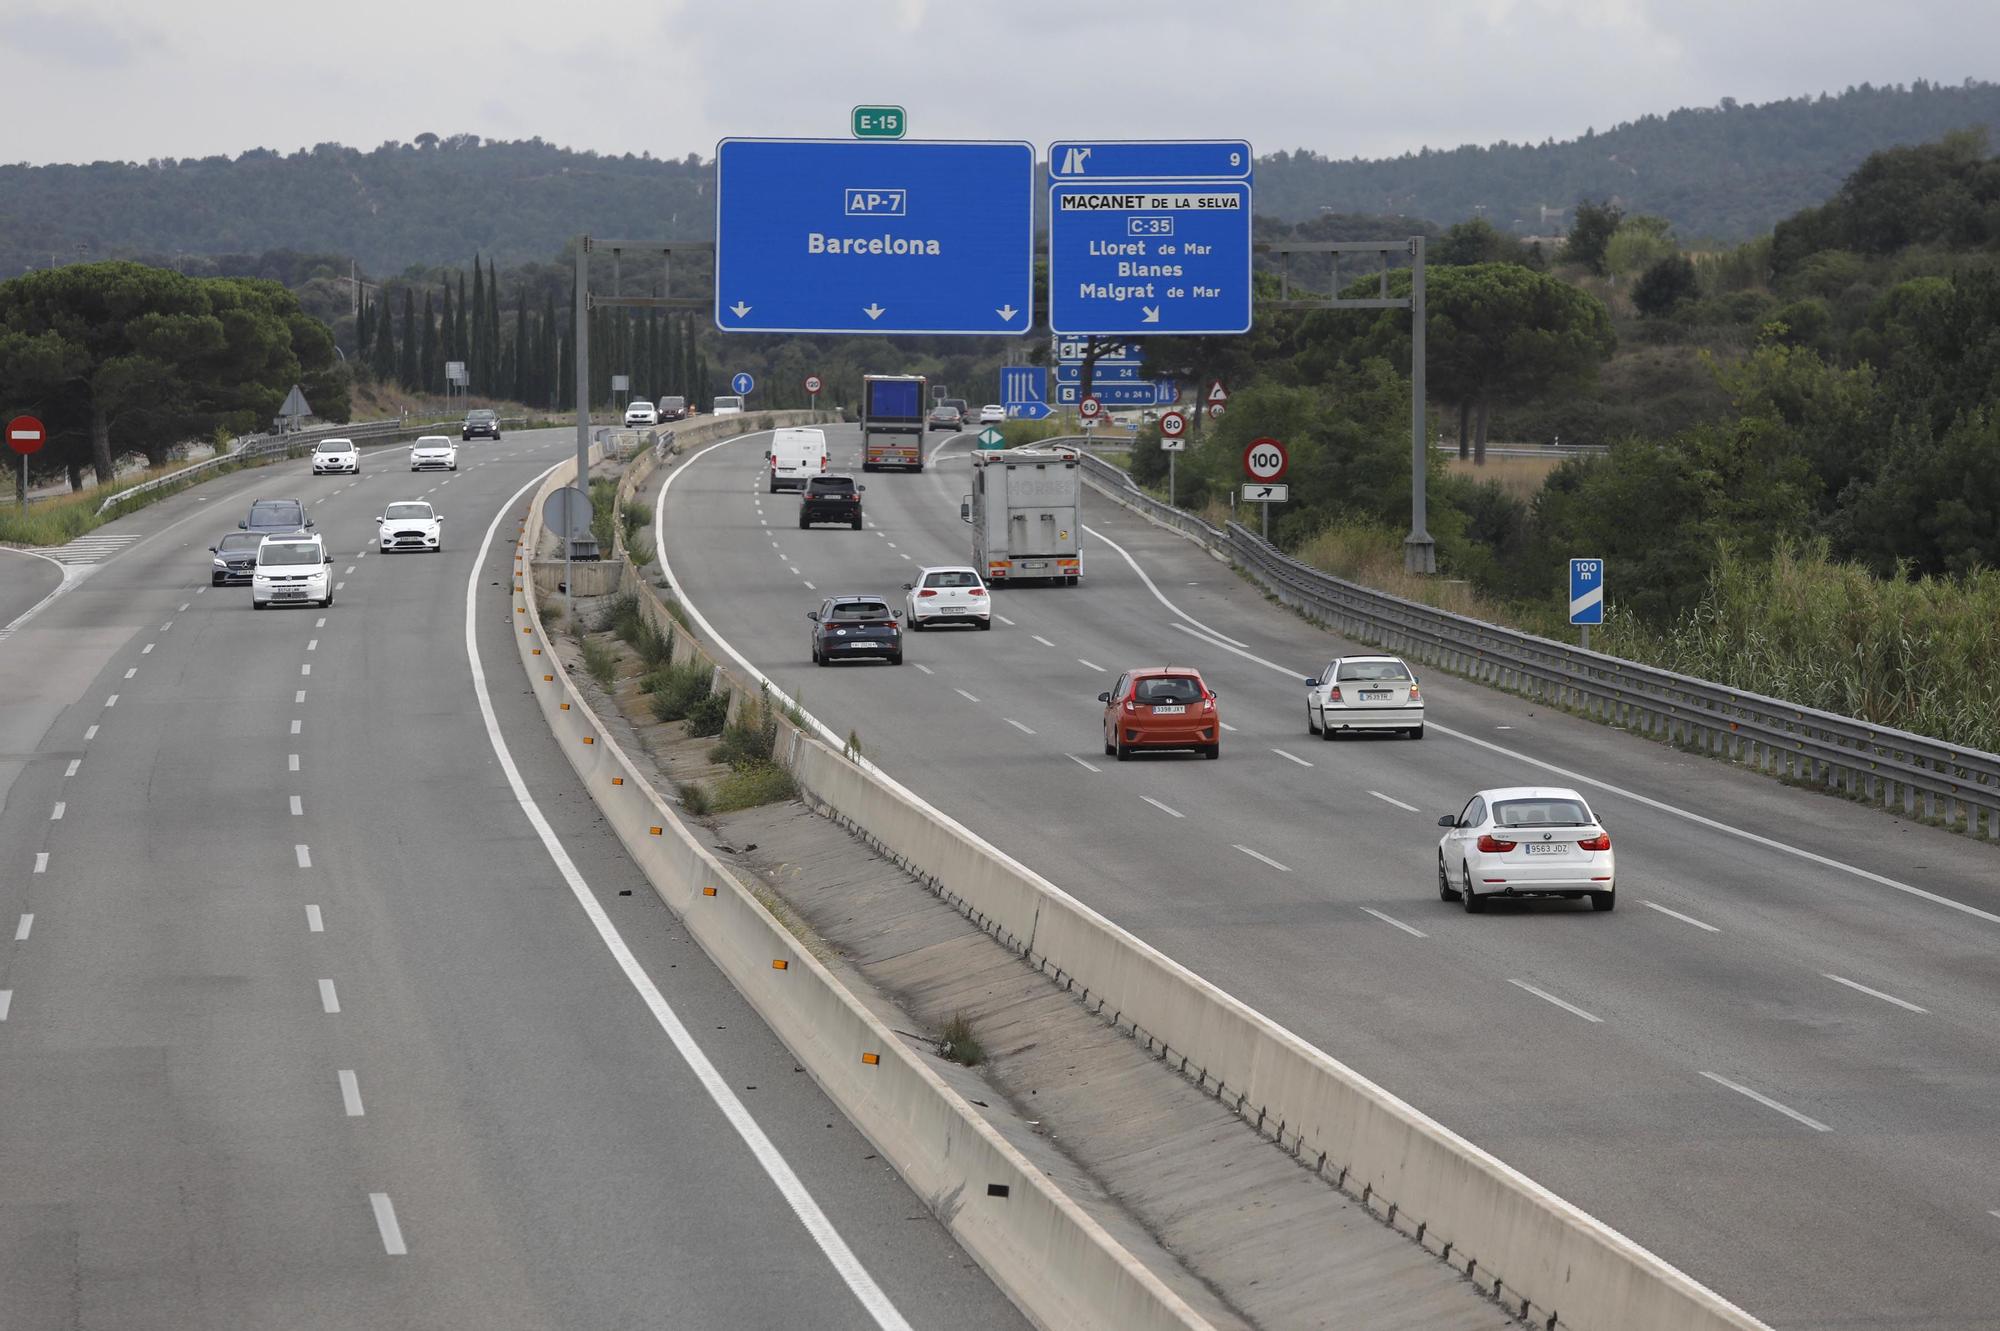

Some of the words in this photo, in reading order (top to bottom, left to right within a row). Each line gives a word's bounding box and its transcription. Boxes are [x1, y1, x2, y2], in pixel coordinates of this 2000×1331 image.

[860, 115, 898, 130] E-15
[1229, 152, 1241, 167] 9
[850, 193, 902, 211] AP-7
[1062, 195, 1146, 210] MAÇANET
[1151, 198, 1169, 209] DE
[1175, 198, 1191, 209] LA
[1197, 197, 1238, 208] SELVA
[1131, 219, 1171, 233] C-35
[808, 232, 941, 256] Barcelona
[1089, 240, 1147, 256] Lloret
[1158, 244, 1176, 255] de
[1184, 243, 1212, 255] Mar
[1118, 261, 1184, 277] Blanes
[1080, 283, 1155, 301] Malgrat
[1166, 287, 1185, 298] de
[1192, 286, 1221, 298] Mar
[1119, 369, 1132, 377] 24
[1065, 390, 1072, 398] S
[1029, 406, 1037, 416] 9
[1165, 420, 1181, 429] 80
[1251, 453, 1280, 468] 100
[1575, 562, 1597, 572] 100
[1580, 572, 1592, 580] m
[1531, 844, 1551, 853] 9563
[1553, 844, 1567, 853] JDZ
